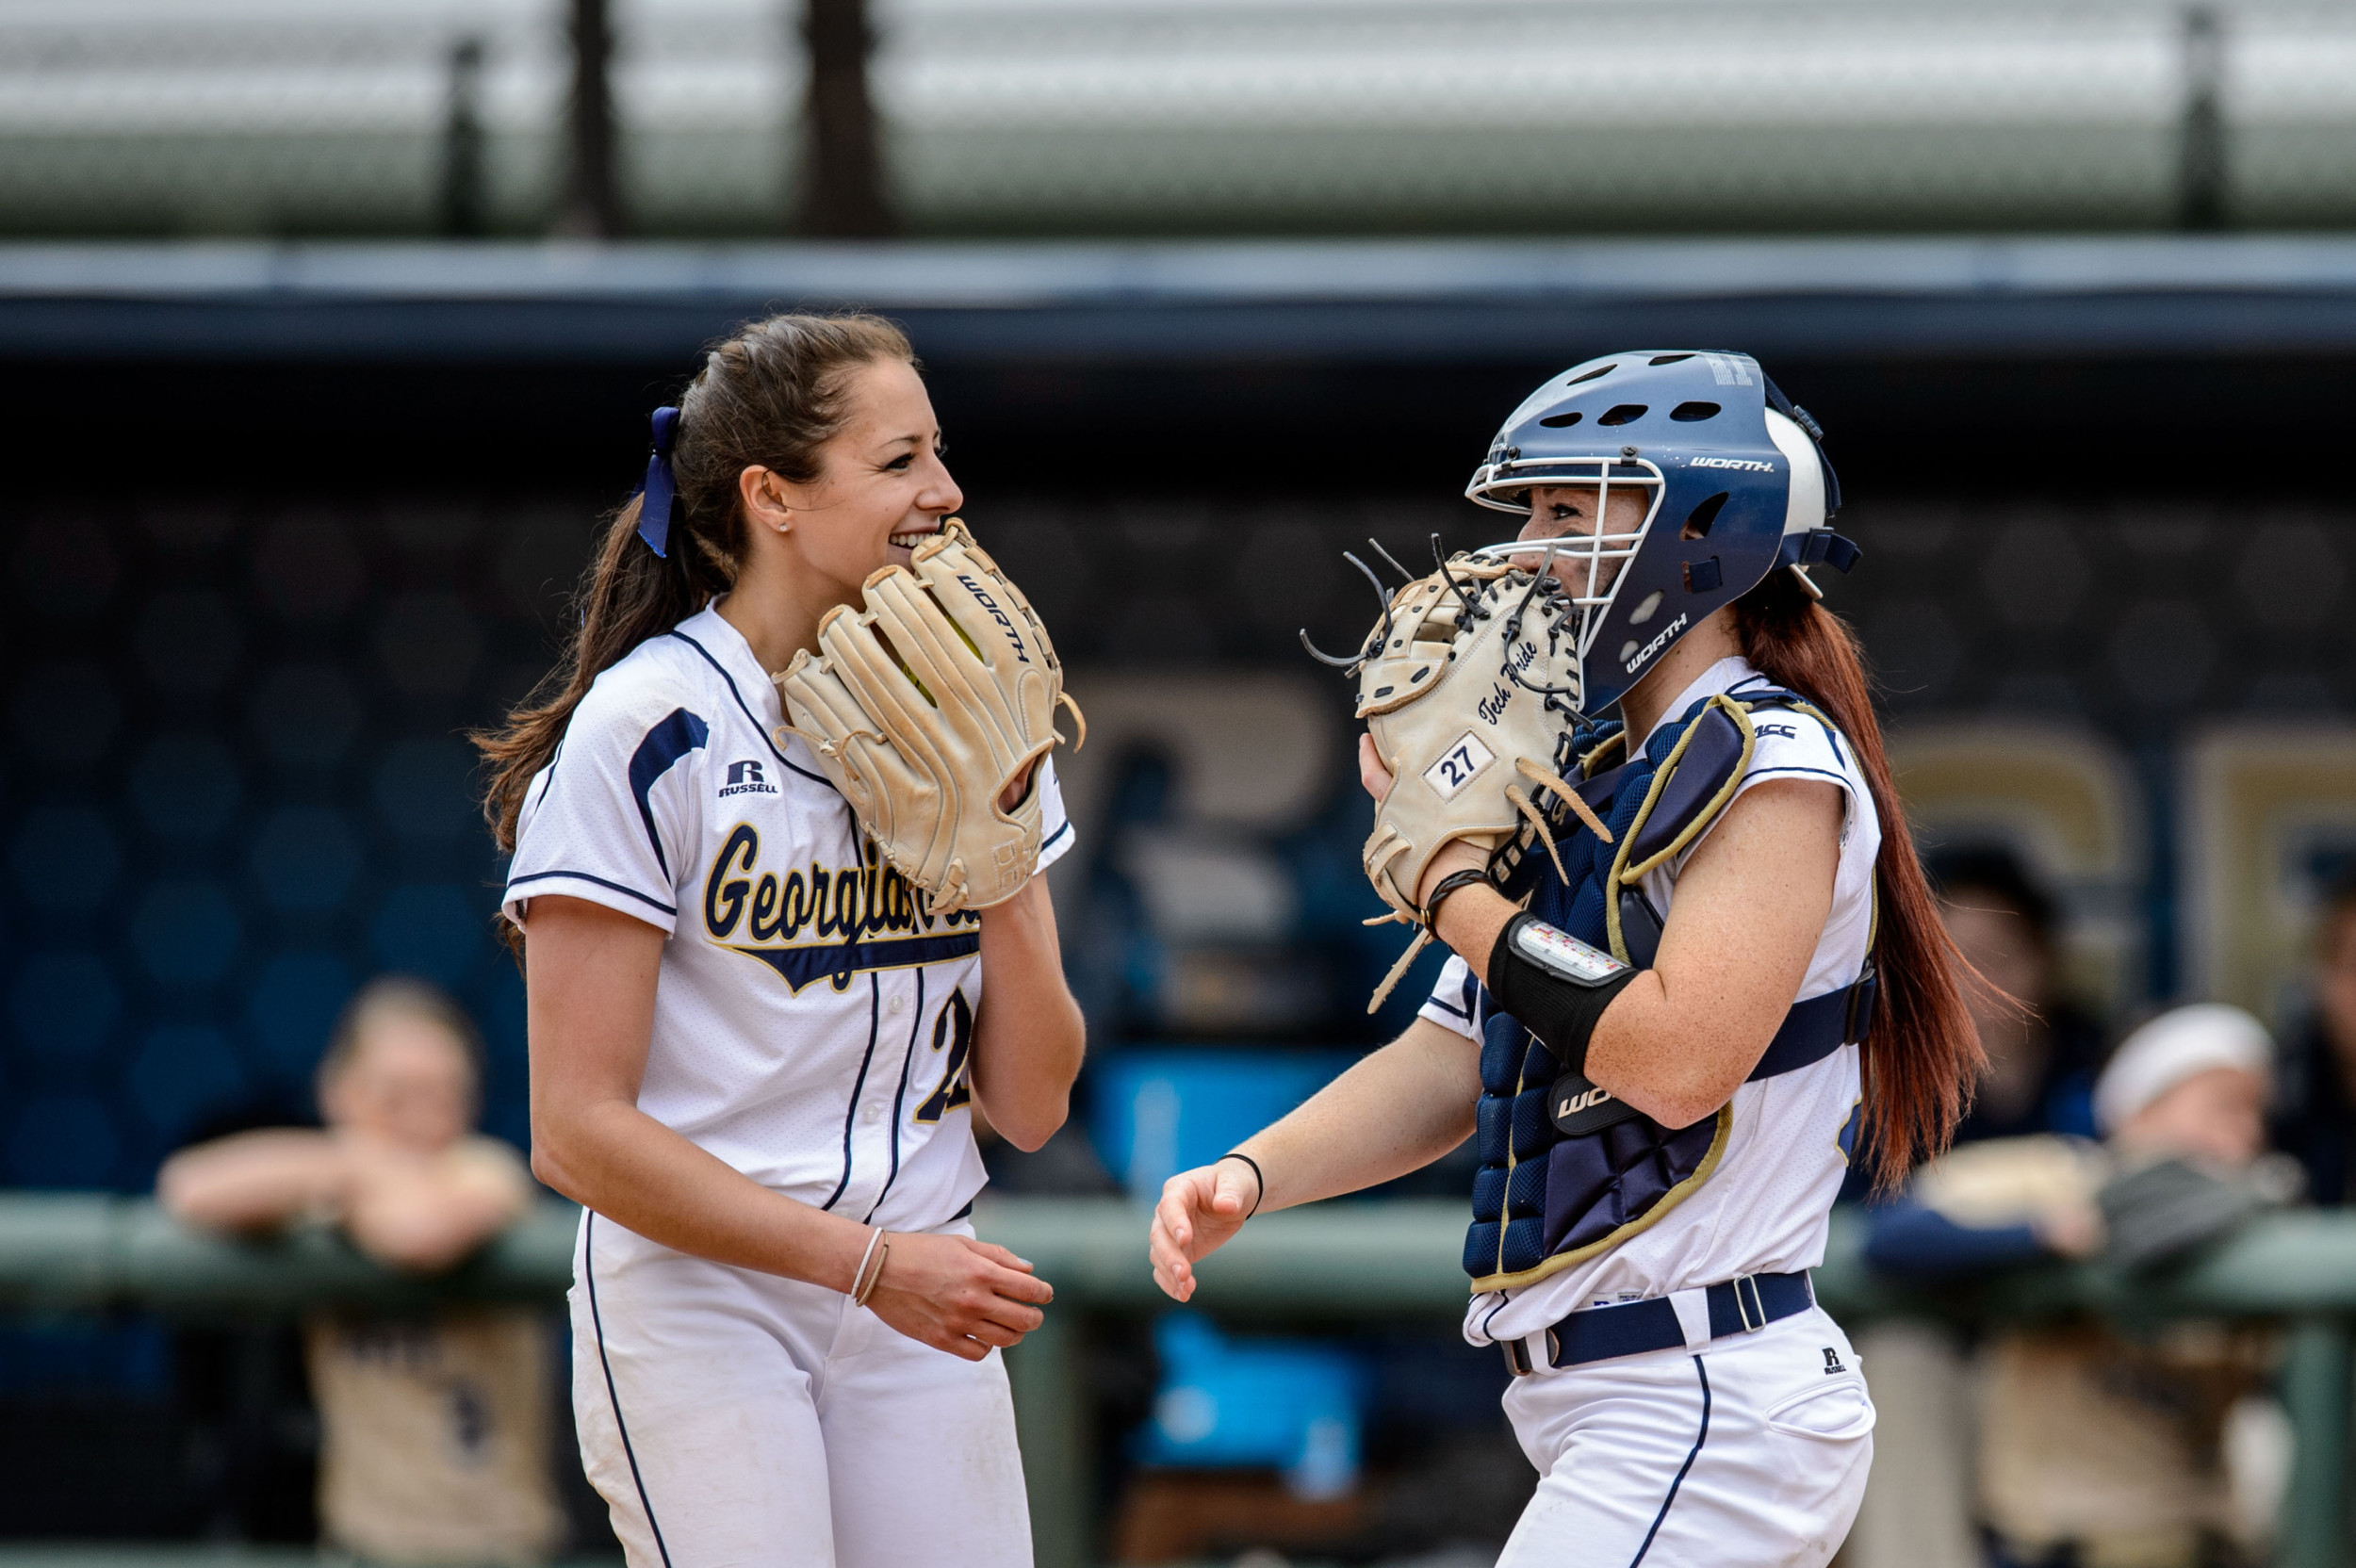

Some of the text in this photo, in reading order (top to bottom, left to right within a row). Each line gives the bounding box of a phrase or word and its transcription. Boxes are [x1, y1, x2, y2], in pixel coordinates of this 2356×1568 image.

[1690, 456, 1775, 473] WORTH
[956, 575, 1030, 663] WORTH
[1626, 612, 1688, 675] WORTH
[1478, 642, 1538, 726] Tech Pride
[718, 783, 778, 798] RUSSELL
[1440, 745, 1477, 788] 27
[703, 821, 914, 994] Georgia
